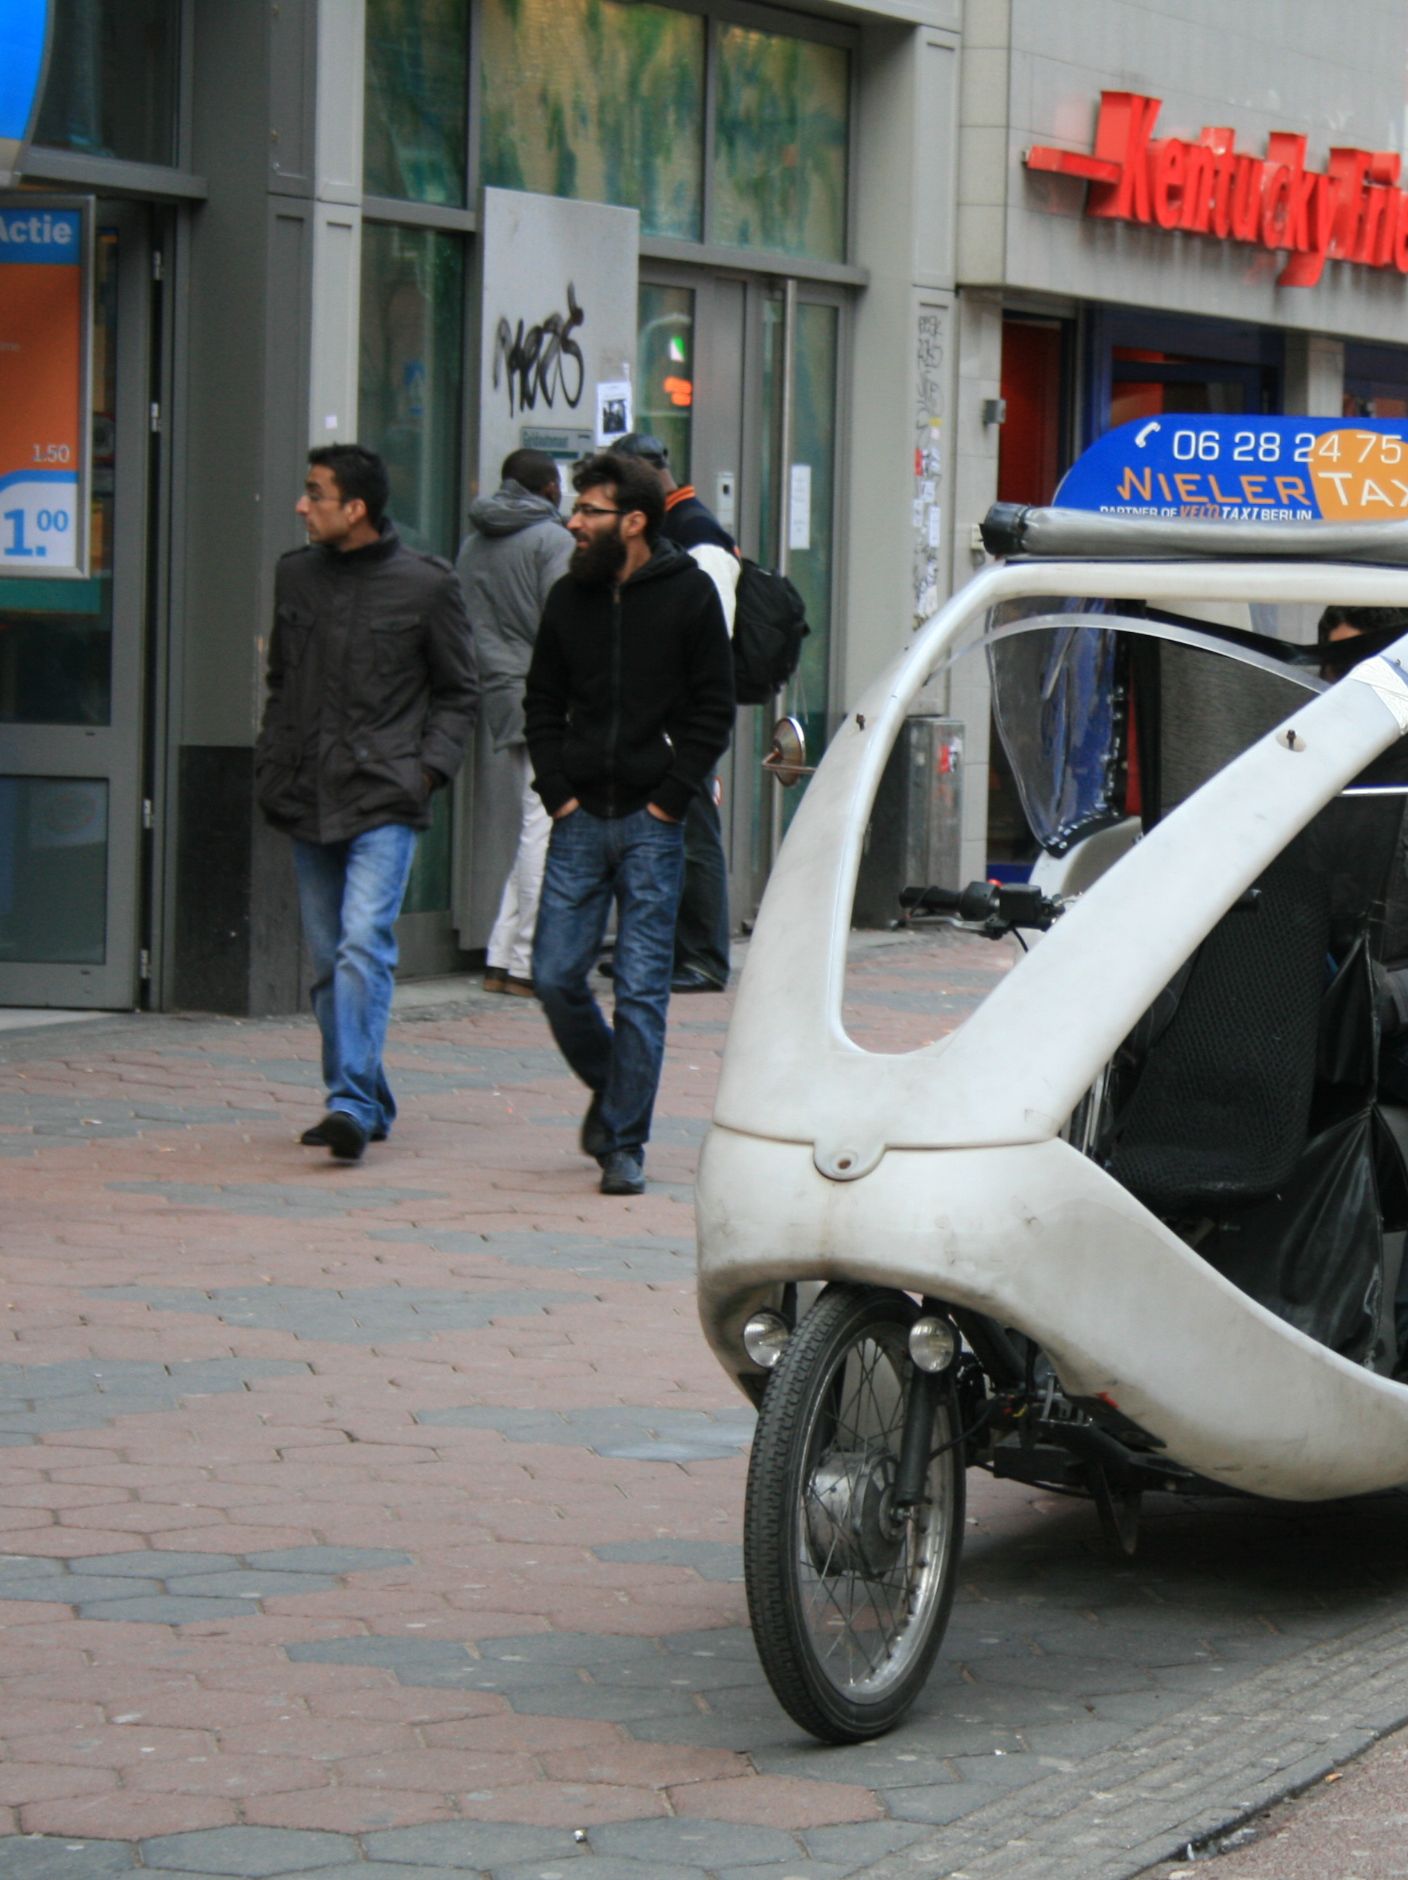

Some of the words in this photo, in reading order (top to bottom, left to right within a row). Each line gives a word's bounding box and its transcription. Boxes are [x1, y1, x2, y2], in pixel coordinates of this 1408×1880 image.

[1092, 91, 1334, 287] Kentucky
[32, 443, 70, 463] 1.50
[1173, 430, 1220, 461] 06
[1233, 432, 1280, 462] 28
[1293, 433, 1341, 463] 24
[1356, 434, 1402, 464] 75
[1116, 467, 1312, 505] NIELER
[1161, 507, 1178, 517] OF
[1261, 509, 1312, 520] BERLIN
